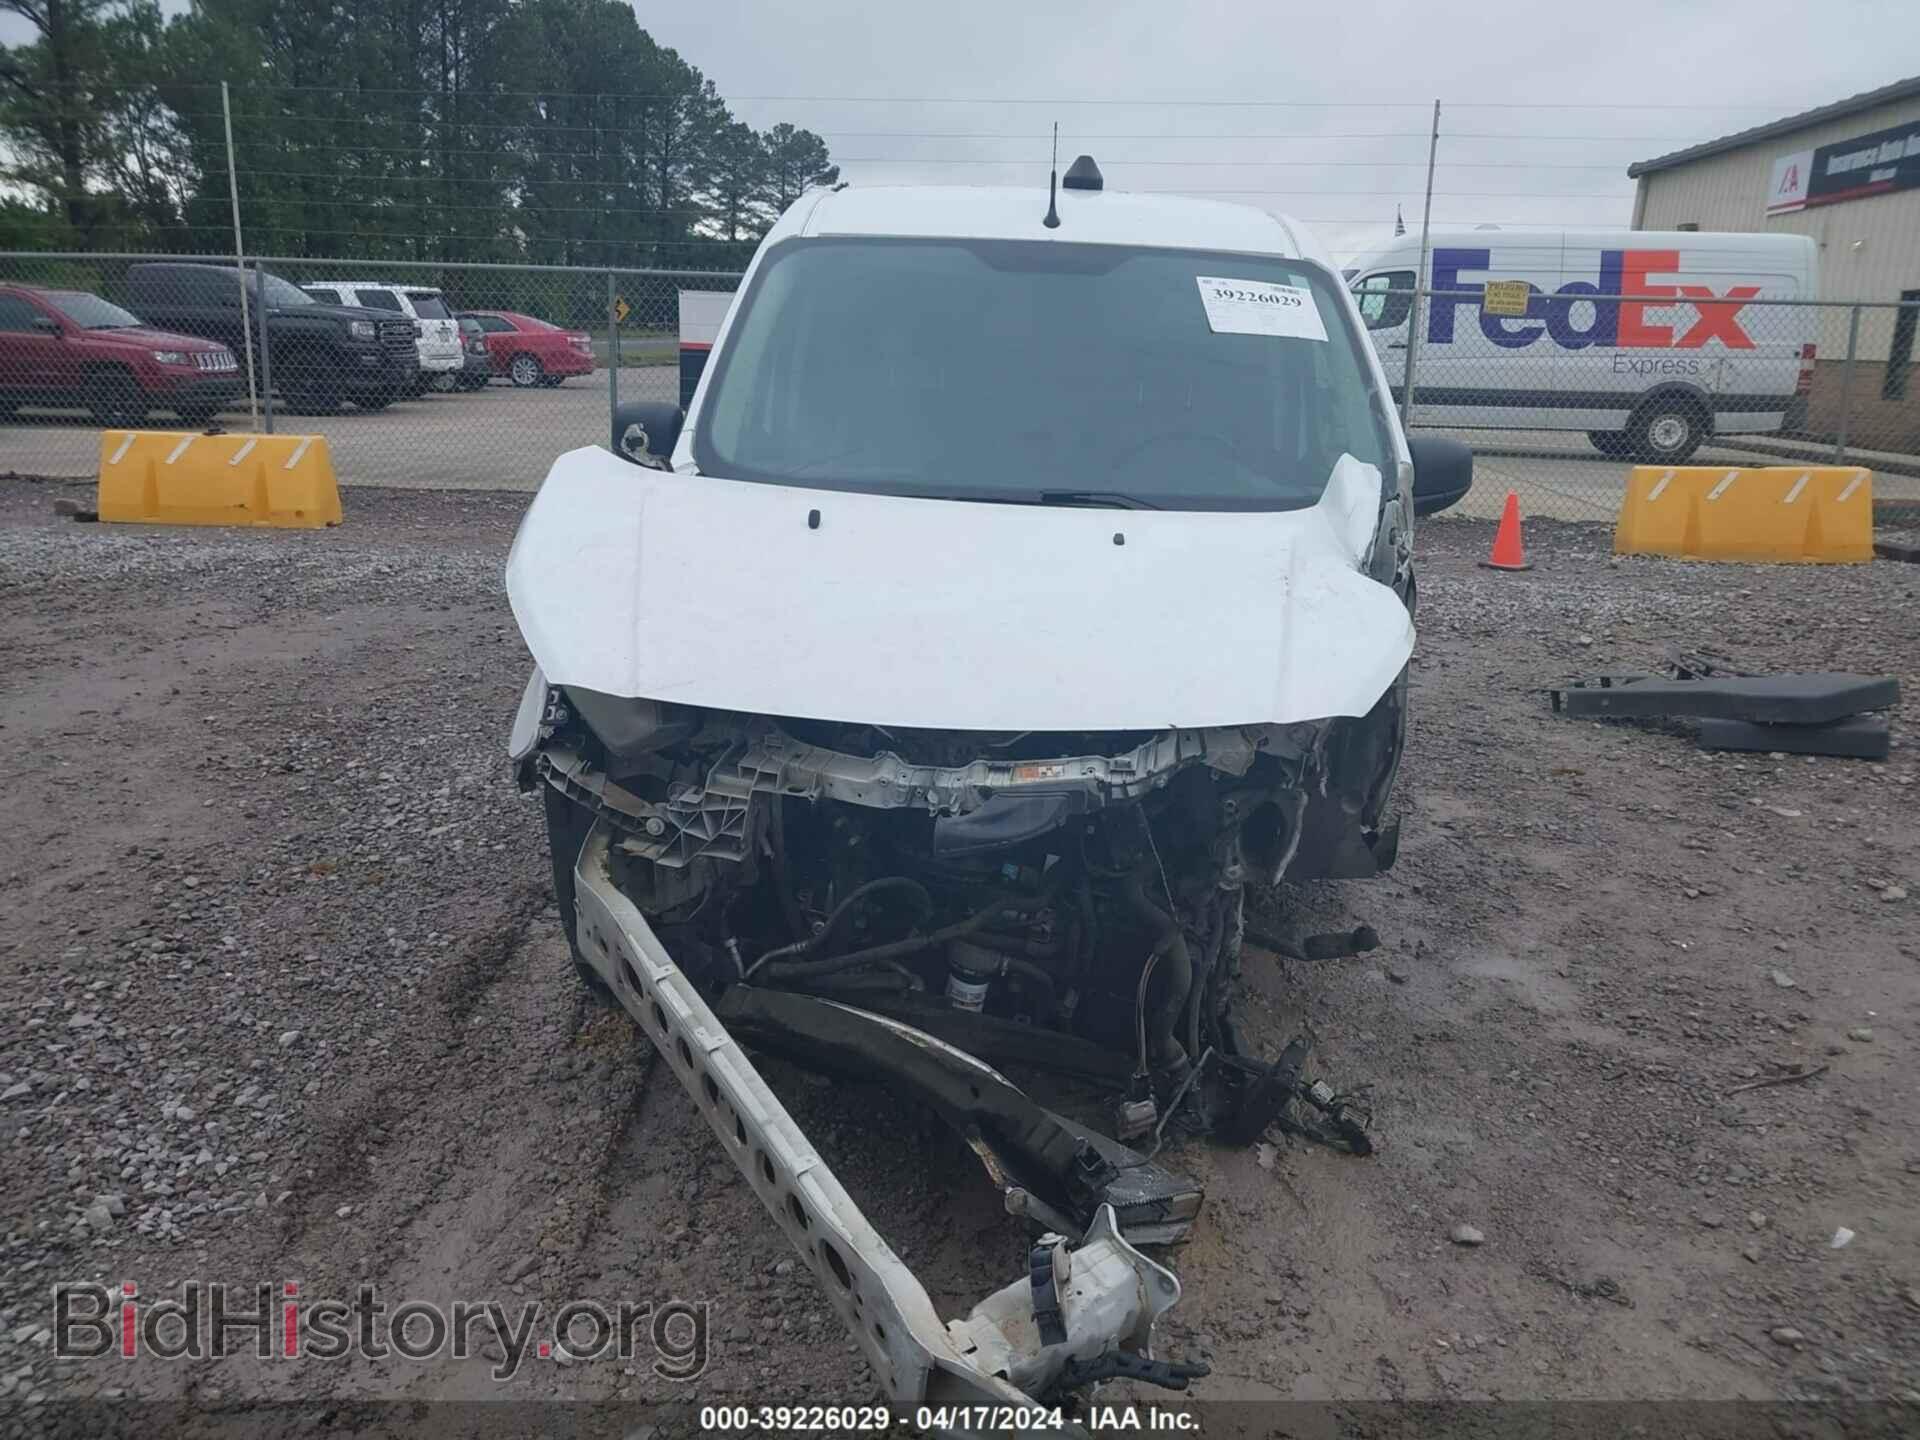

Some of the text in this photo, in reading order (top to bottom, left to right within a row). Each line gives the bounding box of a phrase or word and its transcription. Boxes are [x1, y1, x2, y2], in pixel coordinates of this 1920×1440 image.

[1213, 288, 1302, 307] 39226029
[1428, 248, 1761, 349] FedEx
[1612, 353, 1698, 377] Express
